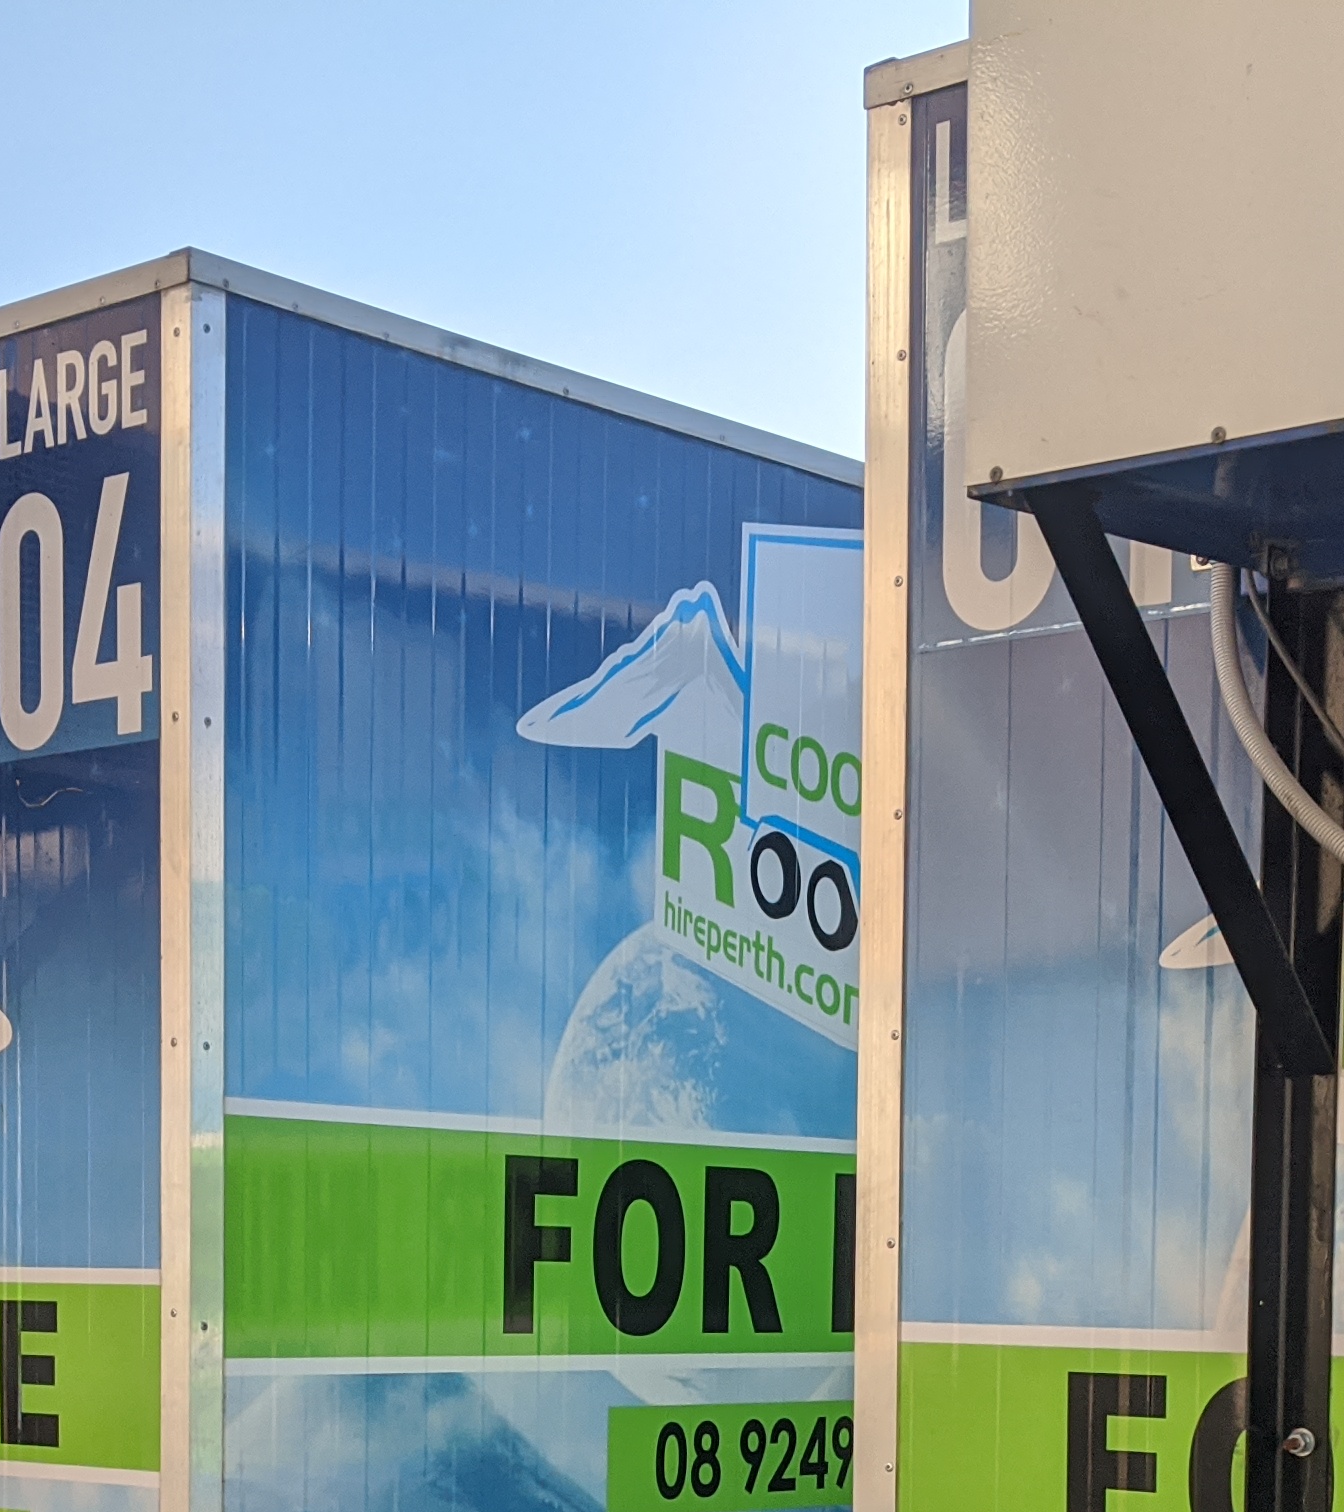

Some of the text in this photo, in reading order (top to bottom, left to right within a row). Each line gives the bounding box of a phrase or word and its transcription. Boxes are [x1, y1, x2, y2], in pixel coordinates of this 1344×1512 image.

[503, 1155, 783, 1336] FOR
[655, 1415, 854, 1500] 08 9249
